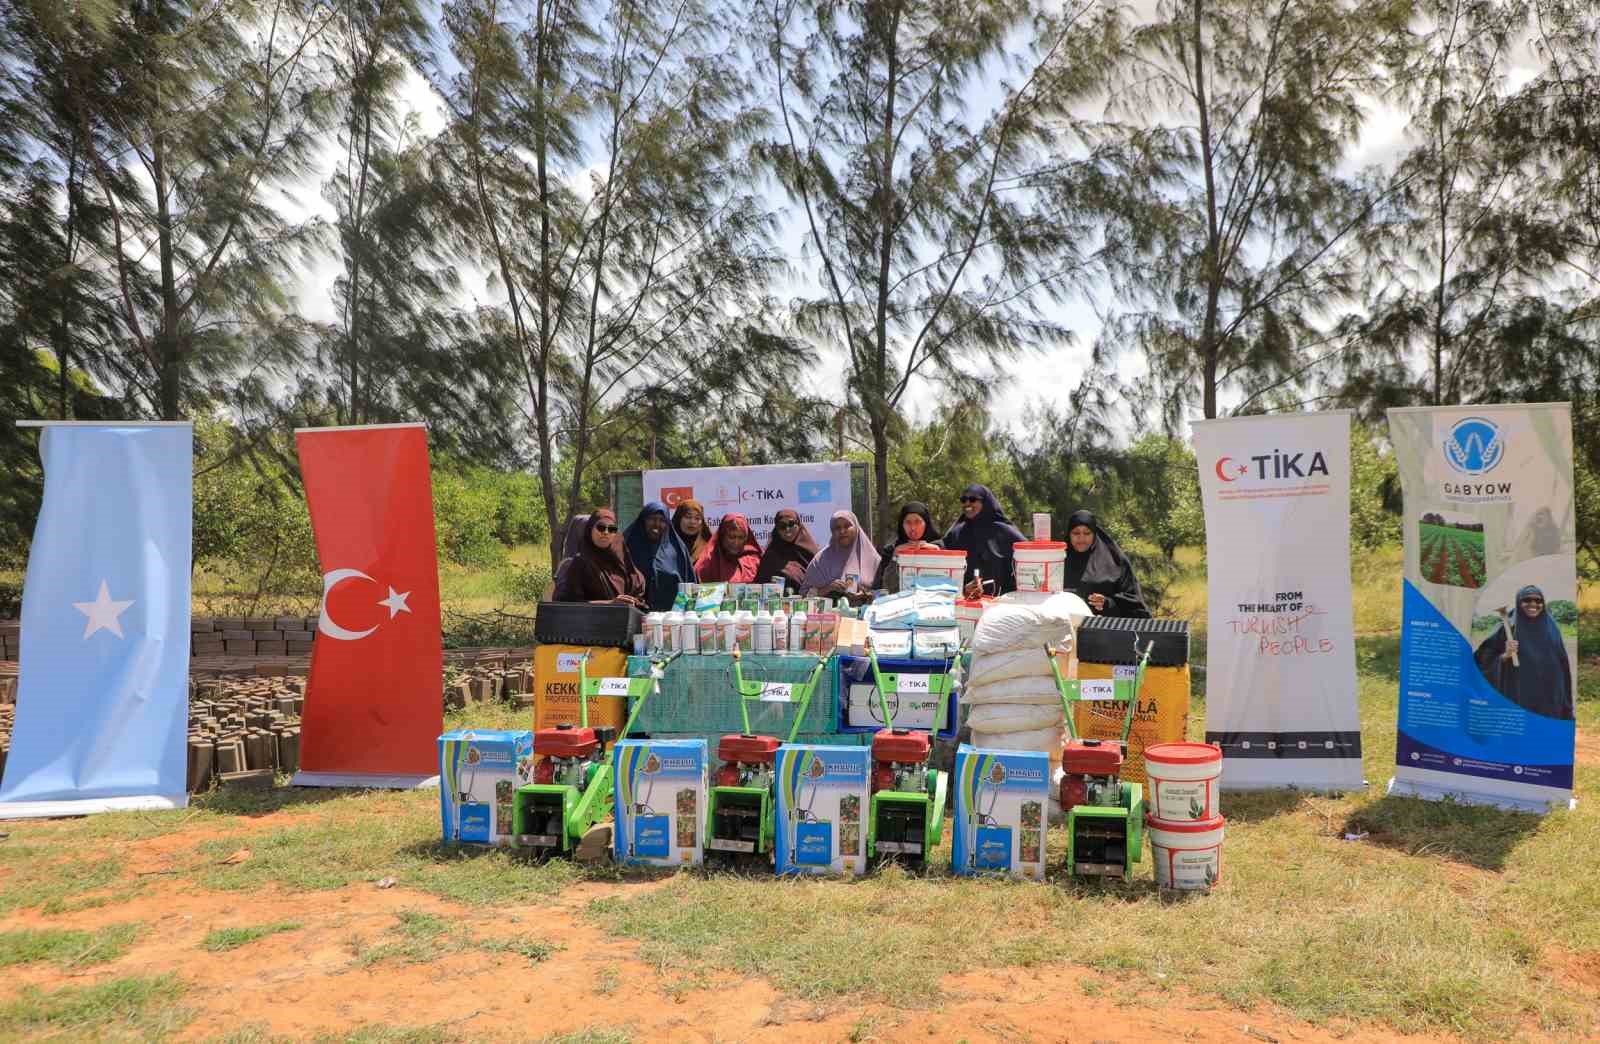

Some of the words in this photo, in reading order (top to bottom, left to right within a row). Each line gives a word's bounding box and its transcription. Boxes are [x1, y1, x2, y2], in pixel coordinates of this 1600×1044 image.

[1251, 449, 1329, 480] TİKA
[1444, 483, 1512, 495] GABYOW
[1275, 591, 1303, 601] FROM
[1238, 603, 1256, 613] THE
[1257, 603, 1287, 613] HEART
[1289, 602, 1303, 612] OF
[1260, 635, 1335, 656] PEOPLE
